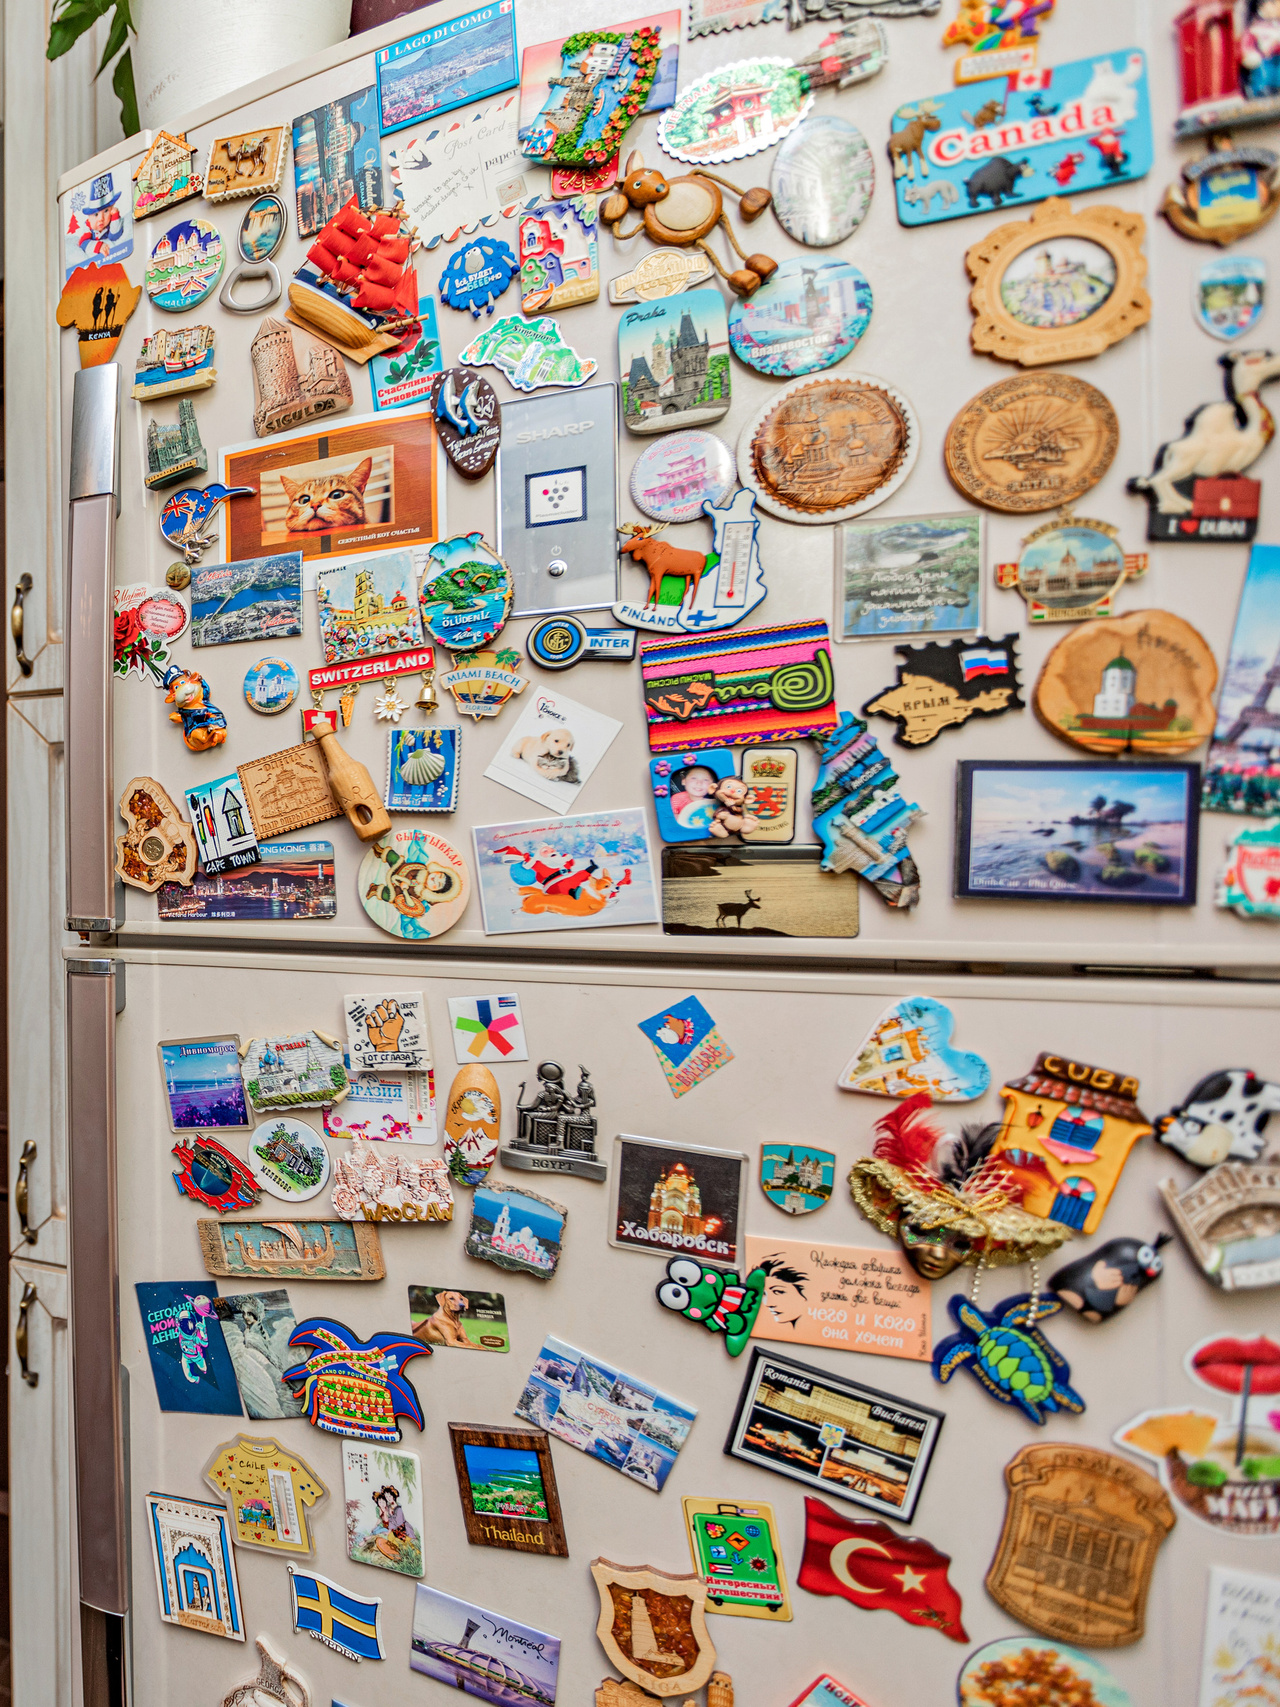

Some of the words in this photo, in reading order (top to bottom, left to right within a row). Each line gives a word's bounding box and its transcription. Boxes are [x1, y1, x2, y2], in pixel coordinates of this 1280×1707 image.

[395, 35, 431, 56] LAGO
[434, 26, 447, 40] DI
[450, 9, 492, 32] COMO
[666, 82, 714, 132] VIETNAM
[444, 134, 473, 160] Post
[477, 121, 506, 140] Card
[933, 103, 1117, 161] Canada
[165, 152, 190, 168] ECUADOR
[484, 148, 519, 170] paper
[626, 306, 667, 325] Praha
[88, 331, 112, 341] KENYA
[512, 324, 556, 343] Singapore
[380, 384, 432, 407] мгновени
[265, 398, 336, 434] SIGULDA
[516, 420, 595, 444] SHARP
[337, 532, 376, 545] СЕКРЕТНЫЙ
[377, 531, 390, 539] КОТ
[391, 526, 420, 537] СЧАСТЬЯ
[1200, 519, 1247, 536] DUBAI
[620, 605, 676, 627] FINLAND
[590, 637, 630, 648] INTER
[311, 652, 430, 686] SWITZERLAND
[447, 670, 482, 684] MIAMI
[485, 670, 521, 687] BEACH
[680, 673, 712, 684] MACHU
[646, 677, 679, 688] PICCHU
[903, 696, 951, 712] КРЫМ
[141, 782, 172, 816] LIETUVA
[259, 845, 278, 854] ONG
[279, 845, 306, 853] KONG
[309, 844, 325, 852] 香港
[206, 860, 226, 873] CAPE
[232, 851, 256, 867] TOWN
[179, 1044, 236, 1058] Дивноморск
[368, 1053, 379, 1062] ОТ
[381, 1053, 412, 1062] СГЛАЗА
[676, 1044, 715, 1082] BRITISH
[683, 1049, 722, 1088] BULLDOG
[1043, 1055, 1140, 1097] CUBA
[348, 1084, 403, 1098] ВРАЗИЯ
[532, 1158, 574, 1172] EGYPT
[622, 1220, 729, 1255] Хабаровск
[147, 1301, 193, 1323] СЕГОДНЯ
[807, 1305, 848, 1324] чего
[855, 1312, 866, 1326] и
[874, 1313, 916, 1332] кого
[149, 1318, 175, 1333] МОЙ
[152, 1330, 180, 1346] ДЕНЬ
[821, 1326, 850, 1340] она
[855, 1330, 904, 1348] хочет
[331, 1376, 369, 1388] LAPLAND
[347, 1370, 364, 1378] FOUR
[365, 1375, 386, 1388] WINDS
[764, 1366, 812, 1391] Romania
[586, 1402, 623, 1426] CYPRUS
[870, 1404, 926, 1433] Bucharest
[320, 1422, 348, 1436] SUOMI
[359, 1431, 396, 1442] FINLAND
[480, 1524, 545, 1546] Thailand
[706, 1575, 776, 1591] Интересных
[310, 1629, 362, 1662] SWEDEN
[256, 1677, 287, 1697] GEORGIA
[638, 1673, 682, 1692] RIGA
